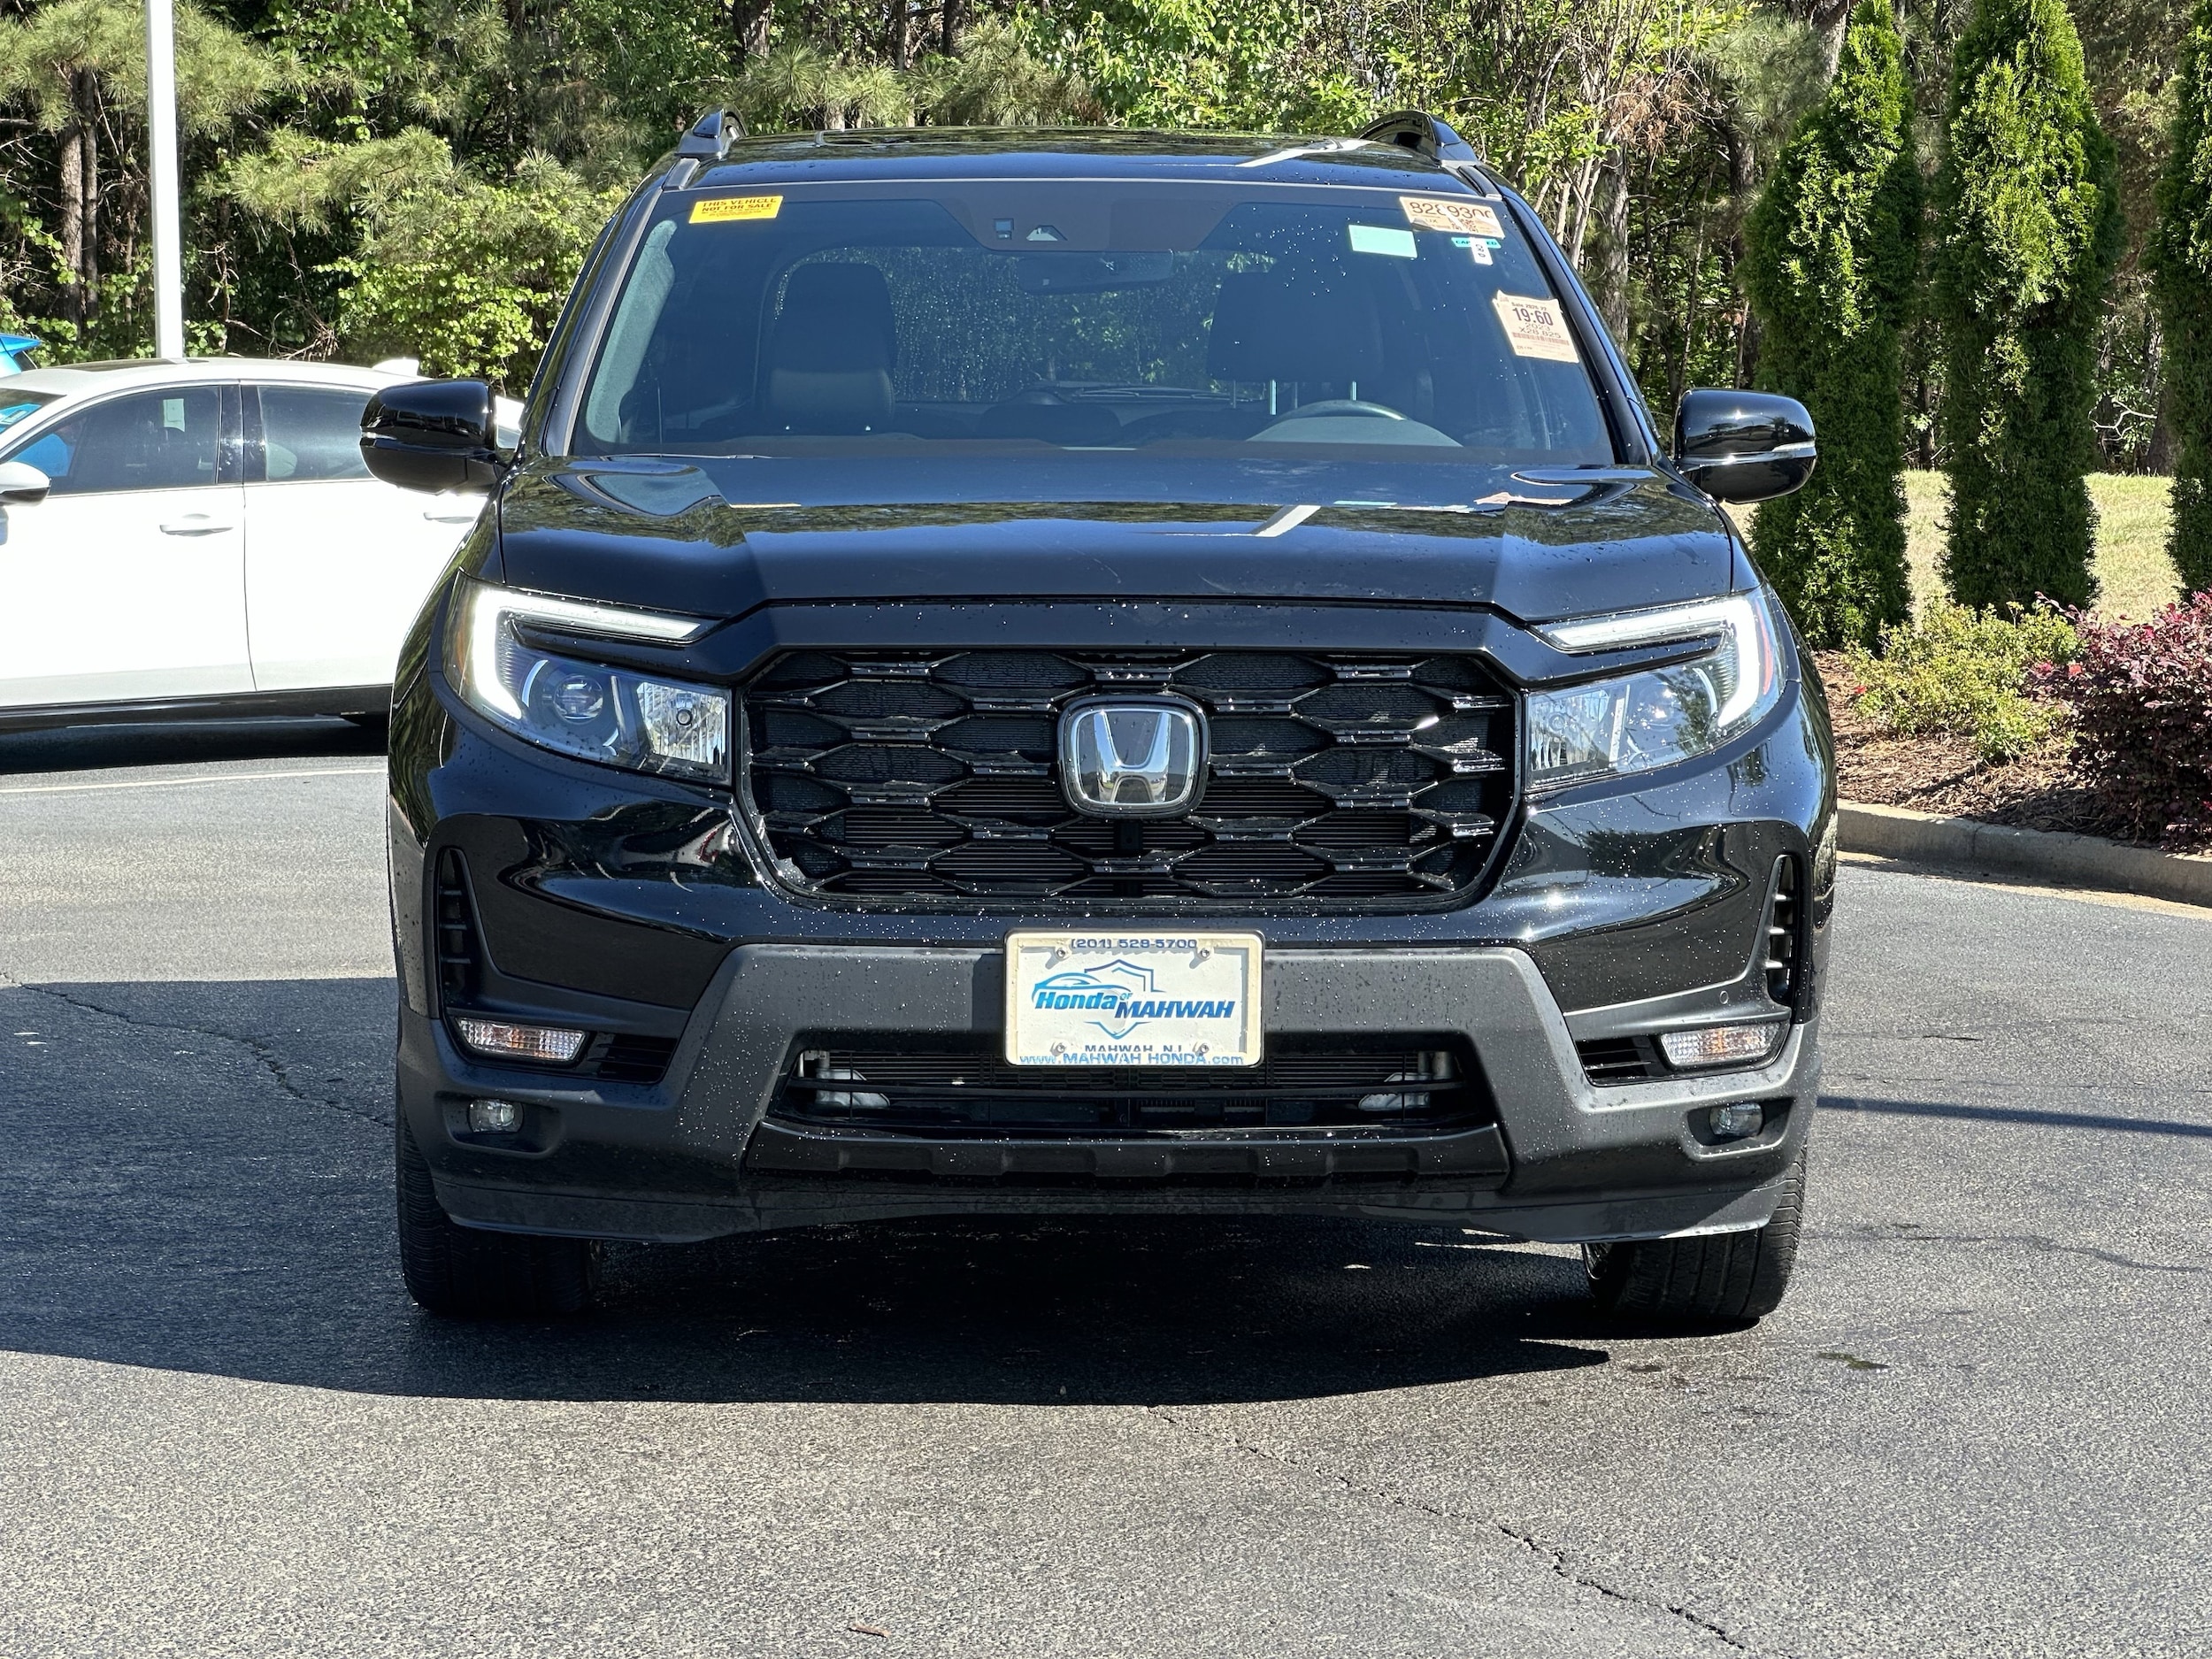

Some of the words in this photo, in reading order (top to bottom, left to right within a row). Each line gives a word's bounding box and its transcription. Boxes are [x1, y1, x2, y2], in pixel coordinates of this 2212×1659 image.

[1512, 307, 1554, 326] 19:60
[1525, 322, 1551, 332] 2023
[1071, 939, 1111, 949] (201)
[1034, 992, 1117, 1010] Honda
[1114, 1001, 1236, 1018] MAHWAH
